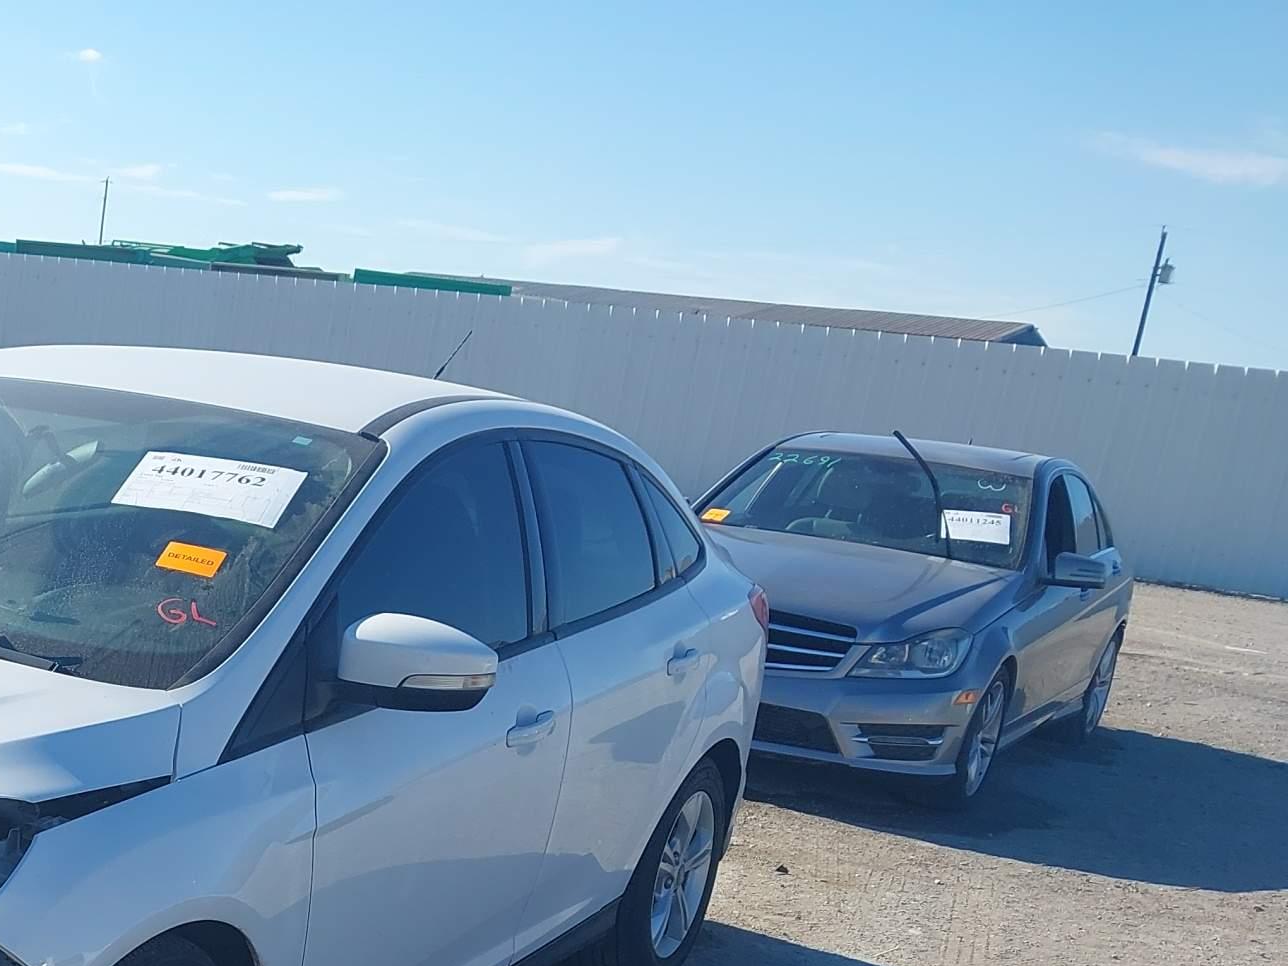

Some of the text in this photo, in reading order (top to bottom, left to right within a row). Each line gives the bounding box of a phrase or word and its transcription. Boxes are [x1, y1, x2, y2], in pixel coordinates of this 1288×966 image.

[151, 464, 267, 488] 44017762
[167, 551, 215, 566] DETAILED
[157, 598, 217, 626] GL
